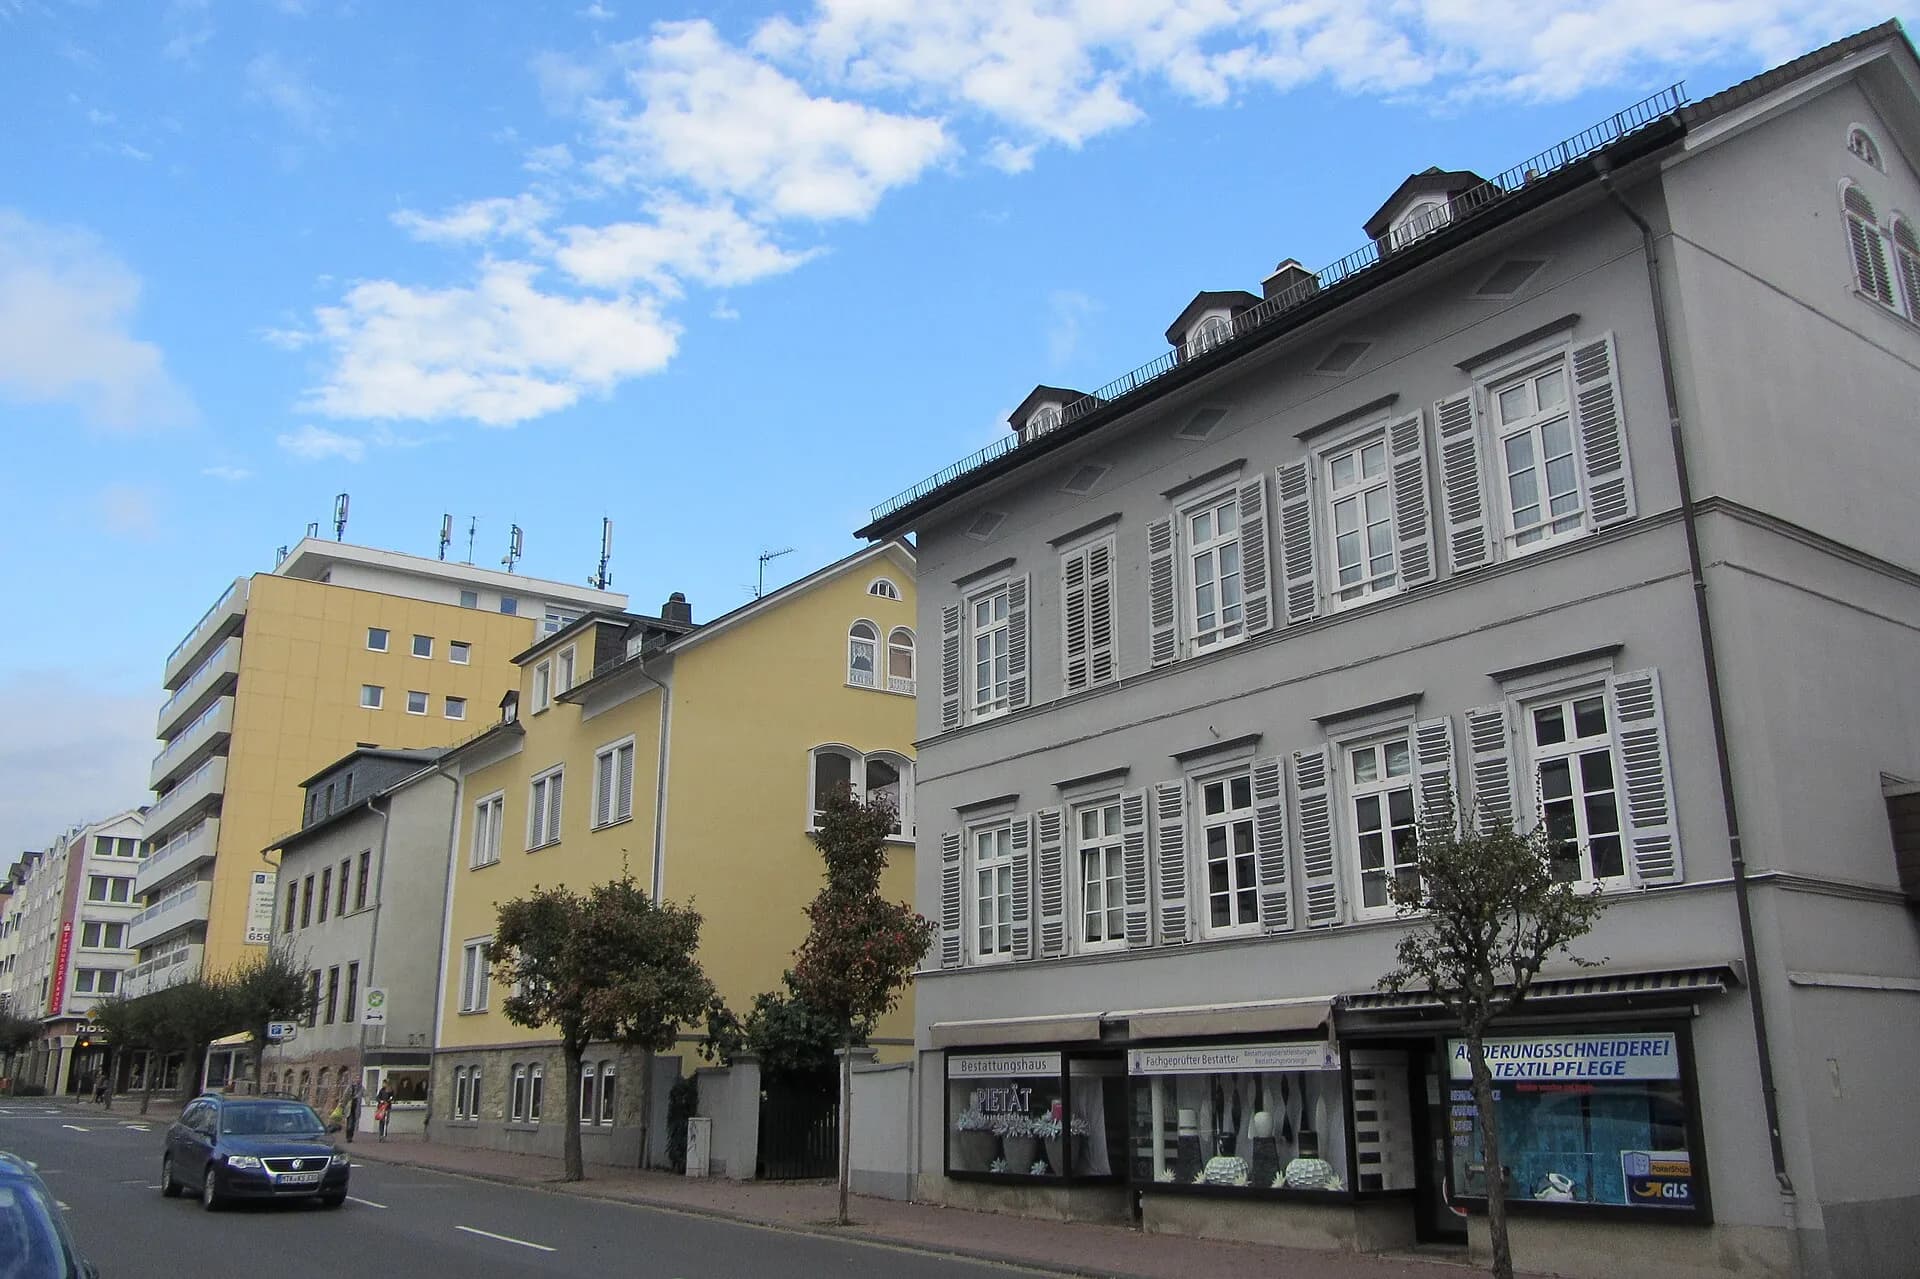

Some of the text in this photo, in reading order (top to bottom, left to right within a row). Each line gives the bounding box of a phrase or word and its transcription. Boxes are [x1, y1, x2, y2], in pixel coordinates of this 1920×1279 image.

[1455, 1040, 1670, 1060] ÄDERUNGSSCHNEIDEREI
[961, 1058, 1047, 1074] Bestattungshaus
[1146, 1054, 1239, 1068] Fachgeprüfter Bestatter
[1494, 1060, 1627, 1077] TEXTILPFLEGE
[976, 1083, 1032, 1112] PIETÄT
[1662, 1183, 1688, 1198] GLS
